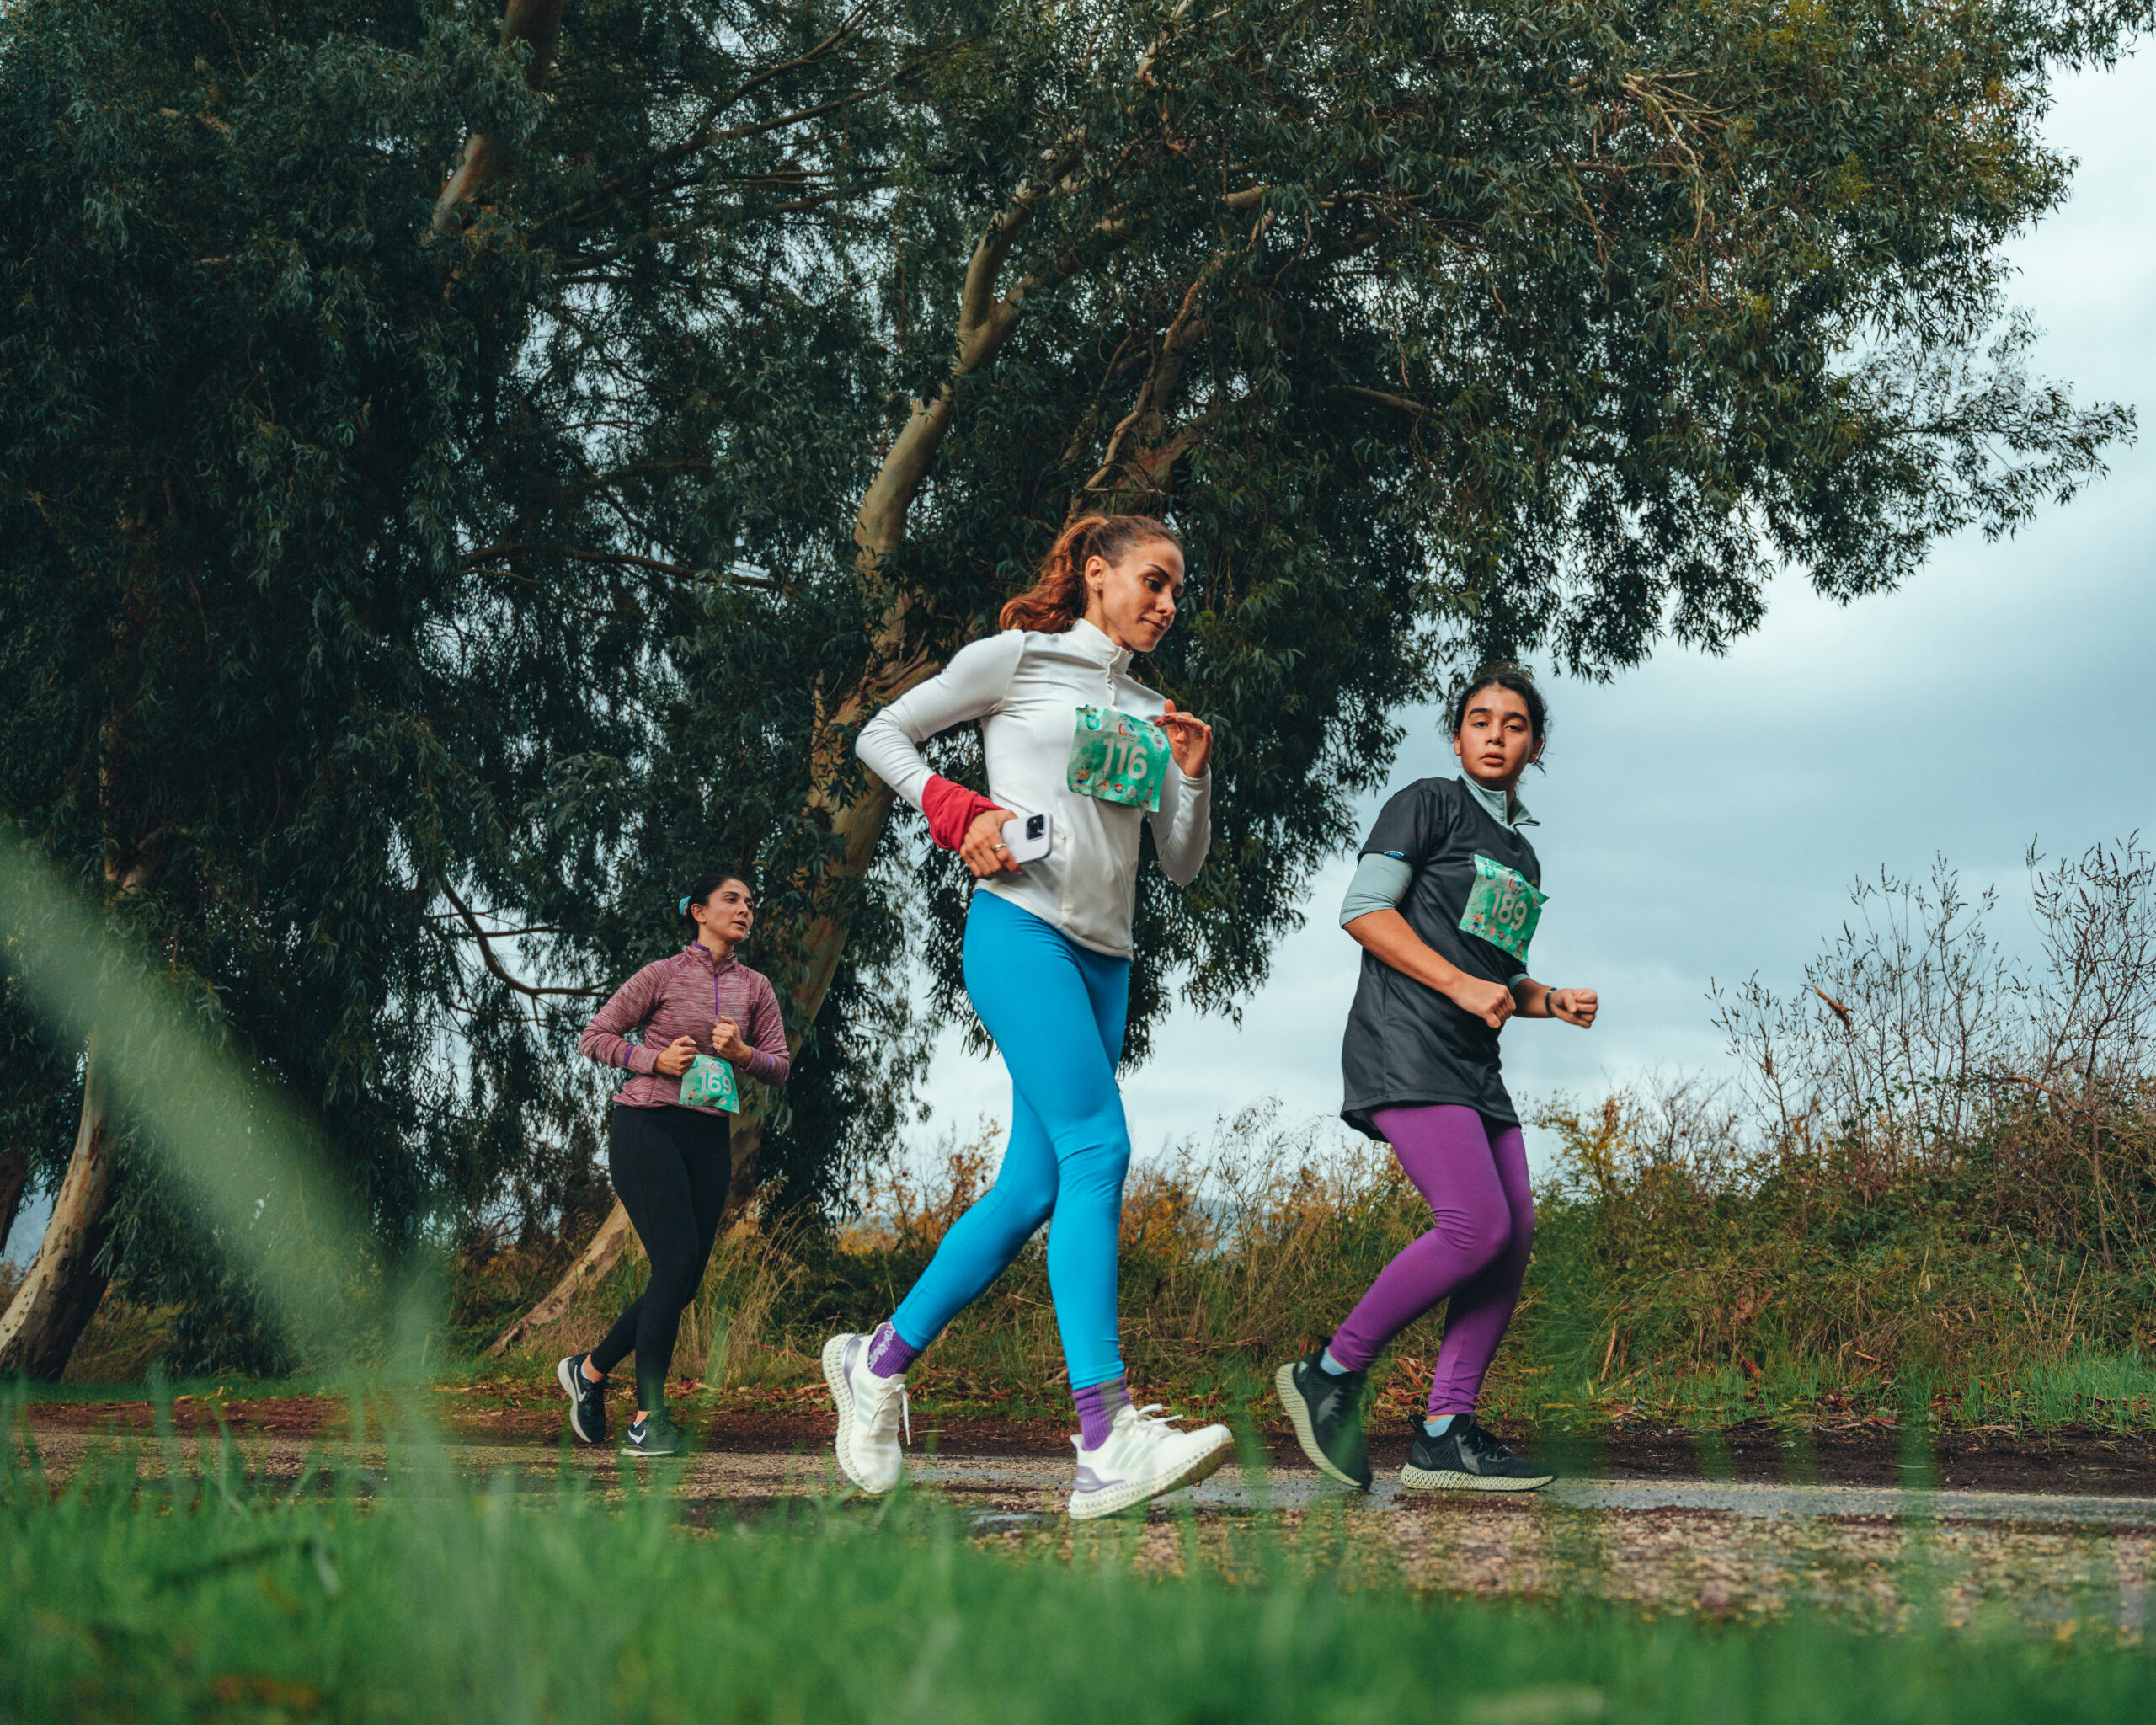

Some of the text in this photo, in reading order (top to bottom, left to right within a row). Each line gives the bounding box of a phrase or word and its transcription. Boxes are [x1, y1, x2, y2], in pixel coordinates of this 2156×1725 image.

[1102, 738, 1148, 780] 116
[1491, 888, 1528, 931] 189
[699, 1071, 732, 1095] 169
